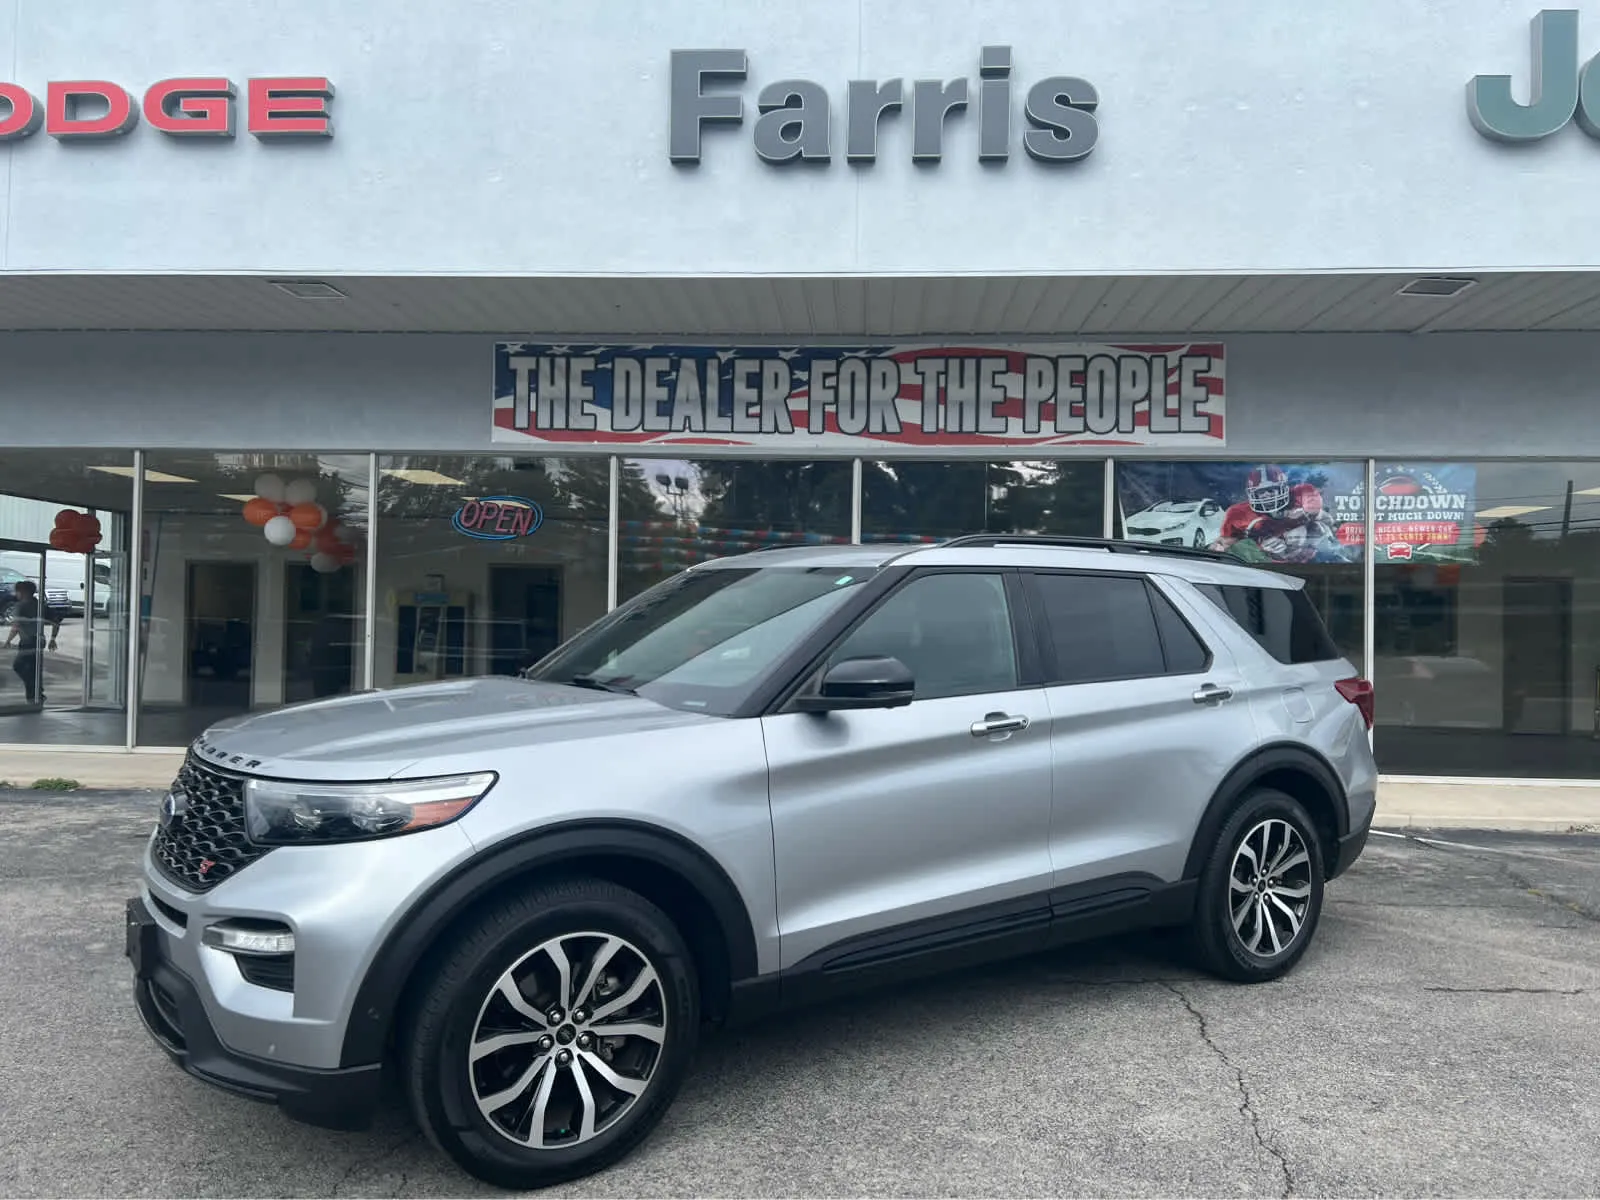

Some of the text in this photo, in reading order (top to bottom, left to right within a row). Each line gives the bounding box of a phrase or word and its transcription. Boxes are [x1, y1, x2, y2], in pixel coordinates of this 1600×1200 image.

[669, 45, 1100, 163] Farris
[1465, 8, 1600, 144] J
[508, 354, 1212, 435] THE DEALER FOR THE PEOPLE
[461, 501, 534, 537] OPEN
[1334, 494, 1467, 511] TOCHDOWN
[1336, 512, 1359, 521] FOR
[1388, 512, 1424, 521] MUCH
[1427, 511, 1465, 521] DOWN!
